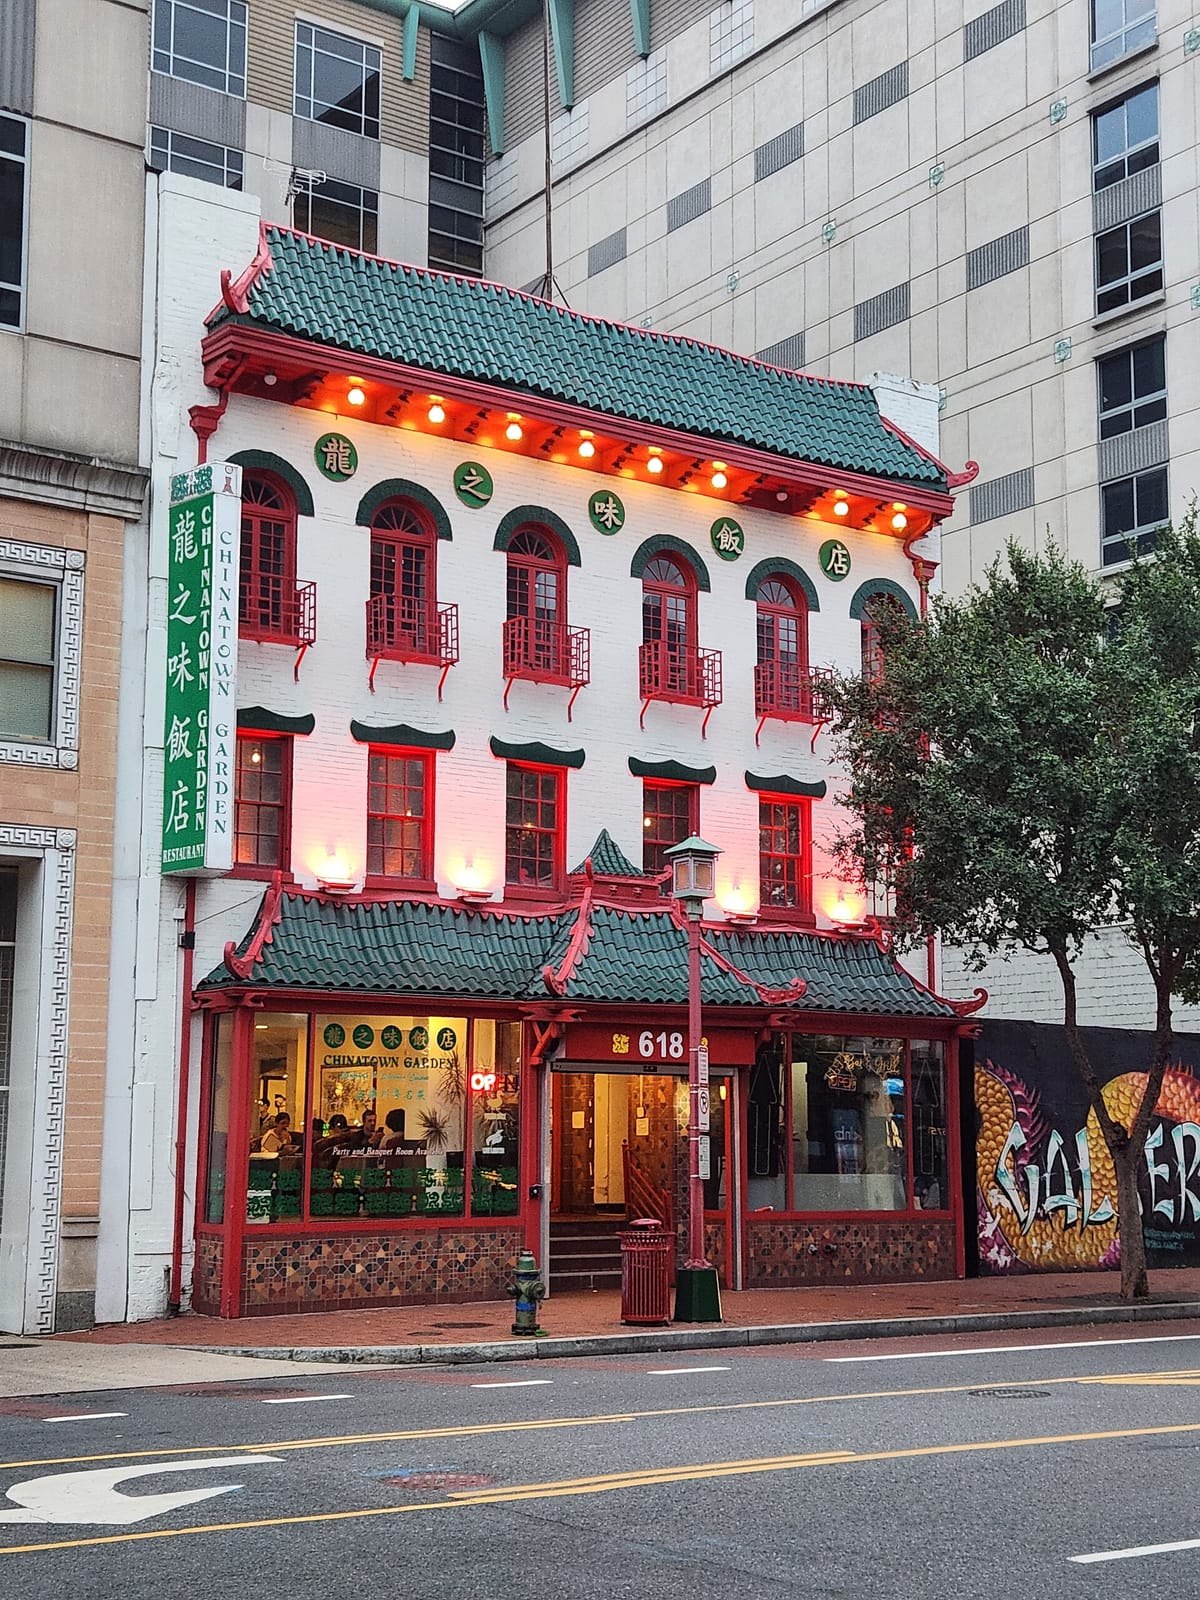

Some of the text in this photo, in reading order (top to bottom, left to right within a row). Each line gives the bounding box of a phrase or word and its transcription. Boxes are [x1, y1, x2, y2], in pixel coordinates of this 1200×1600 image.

[165, 510, 199, 834] 龍之味飯店
[195, 506, 212, 832] CHINATOWN GARDEN
[214, 531, 233, 834] CHINATOWN GARDEN
[162, 843, 205, 863] RESTAURANT
[325, 1026, 456, 1048] 龍之味飯店
[638, 1031, 684, 1058] 618
[323, 1055, 399, 1068] CHINATOWN
[471, 1073, 519, 1092] OPEN
[332, 1146, 350, 1156] Party
[366, 1147, 393, 1157] Banquet
[395, 1147, 413, 1156] Room
